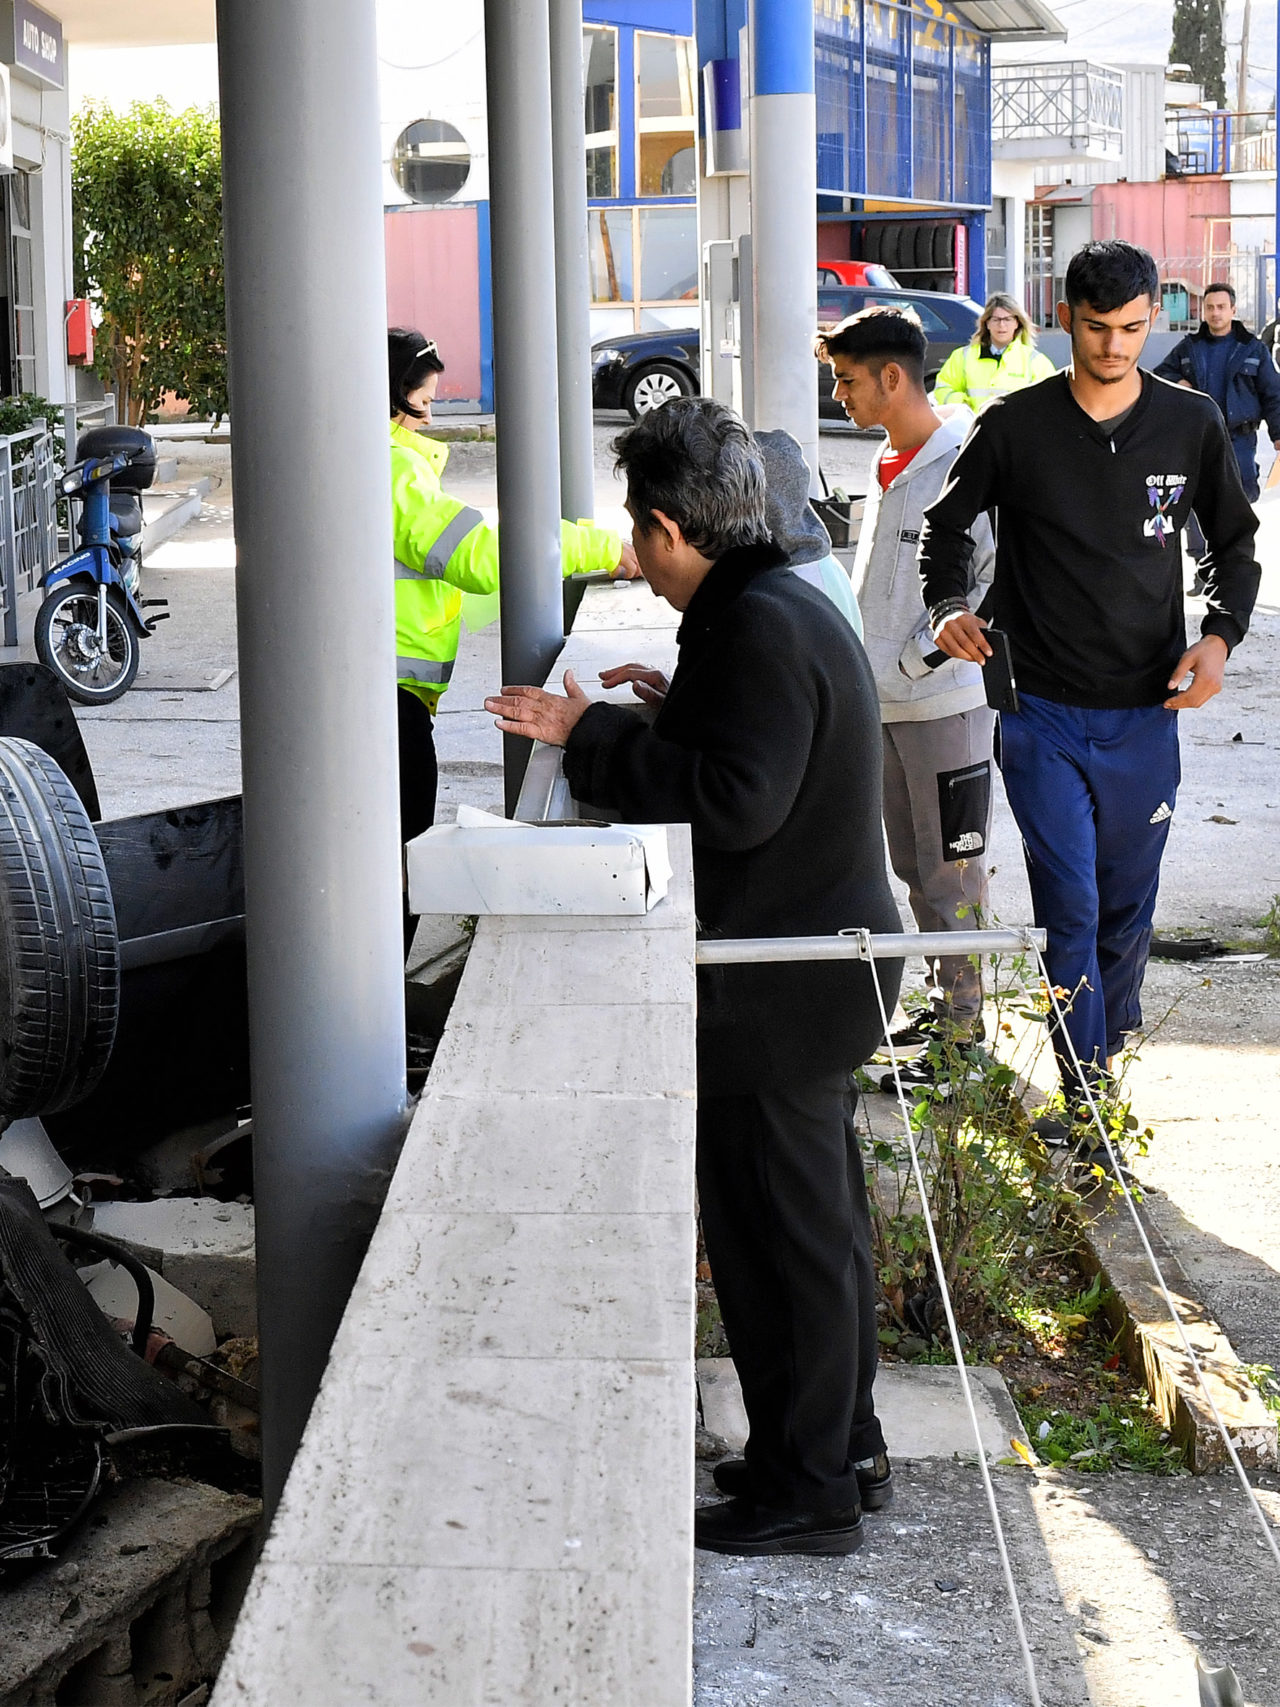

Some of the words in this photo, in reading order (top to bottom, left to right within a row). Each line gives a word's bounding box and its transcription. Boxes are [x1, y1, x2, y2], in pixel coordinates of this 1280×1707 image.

[23, 19, 40, 55] AUTO
[41, 31, 57, 64] SHOP
[53, 552, 91, 575] RACING
[949, 837, 973, 849] NORTH
[959, 832, 972, 842] THE
